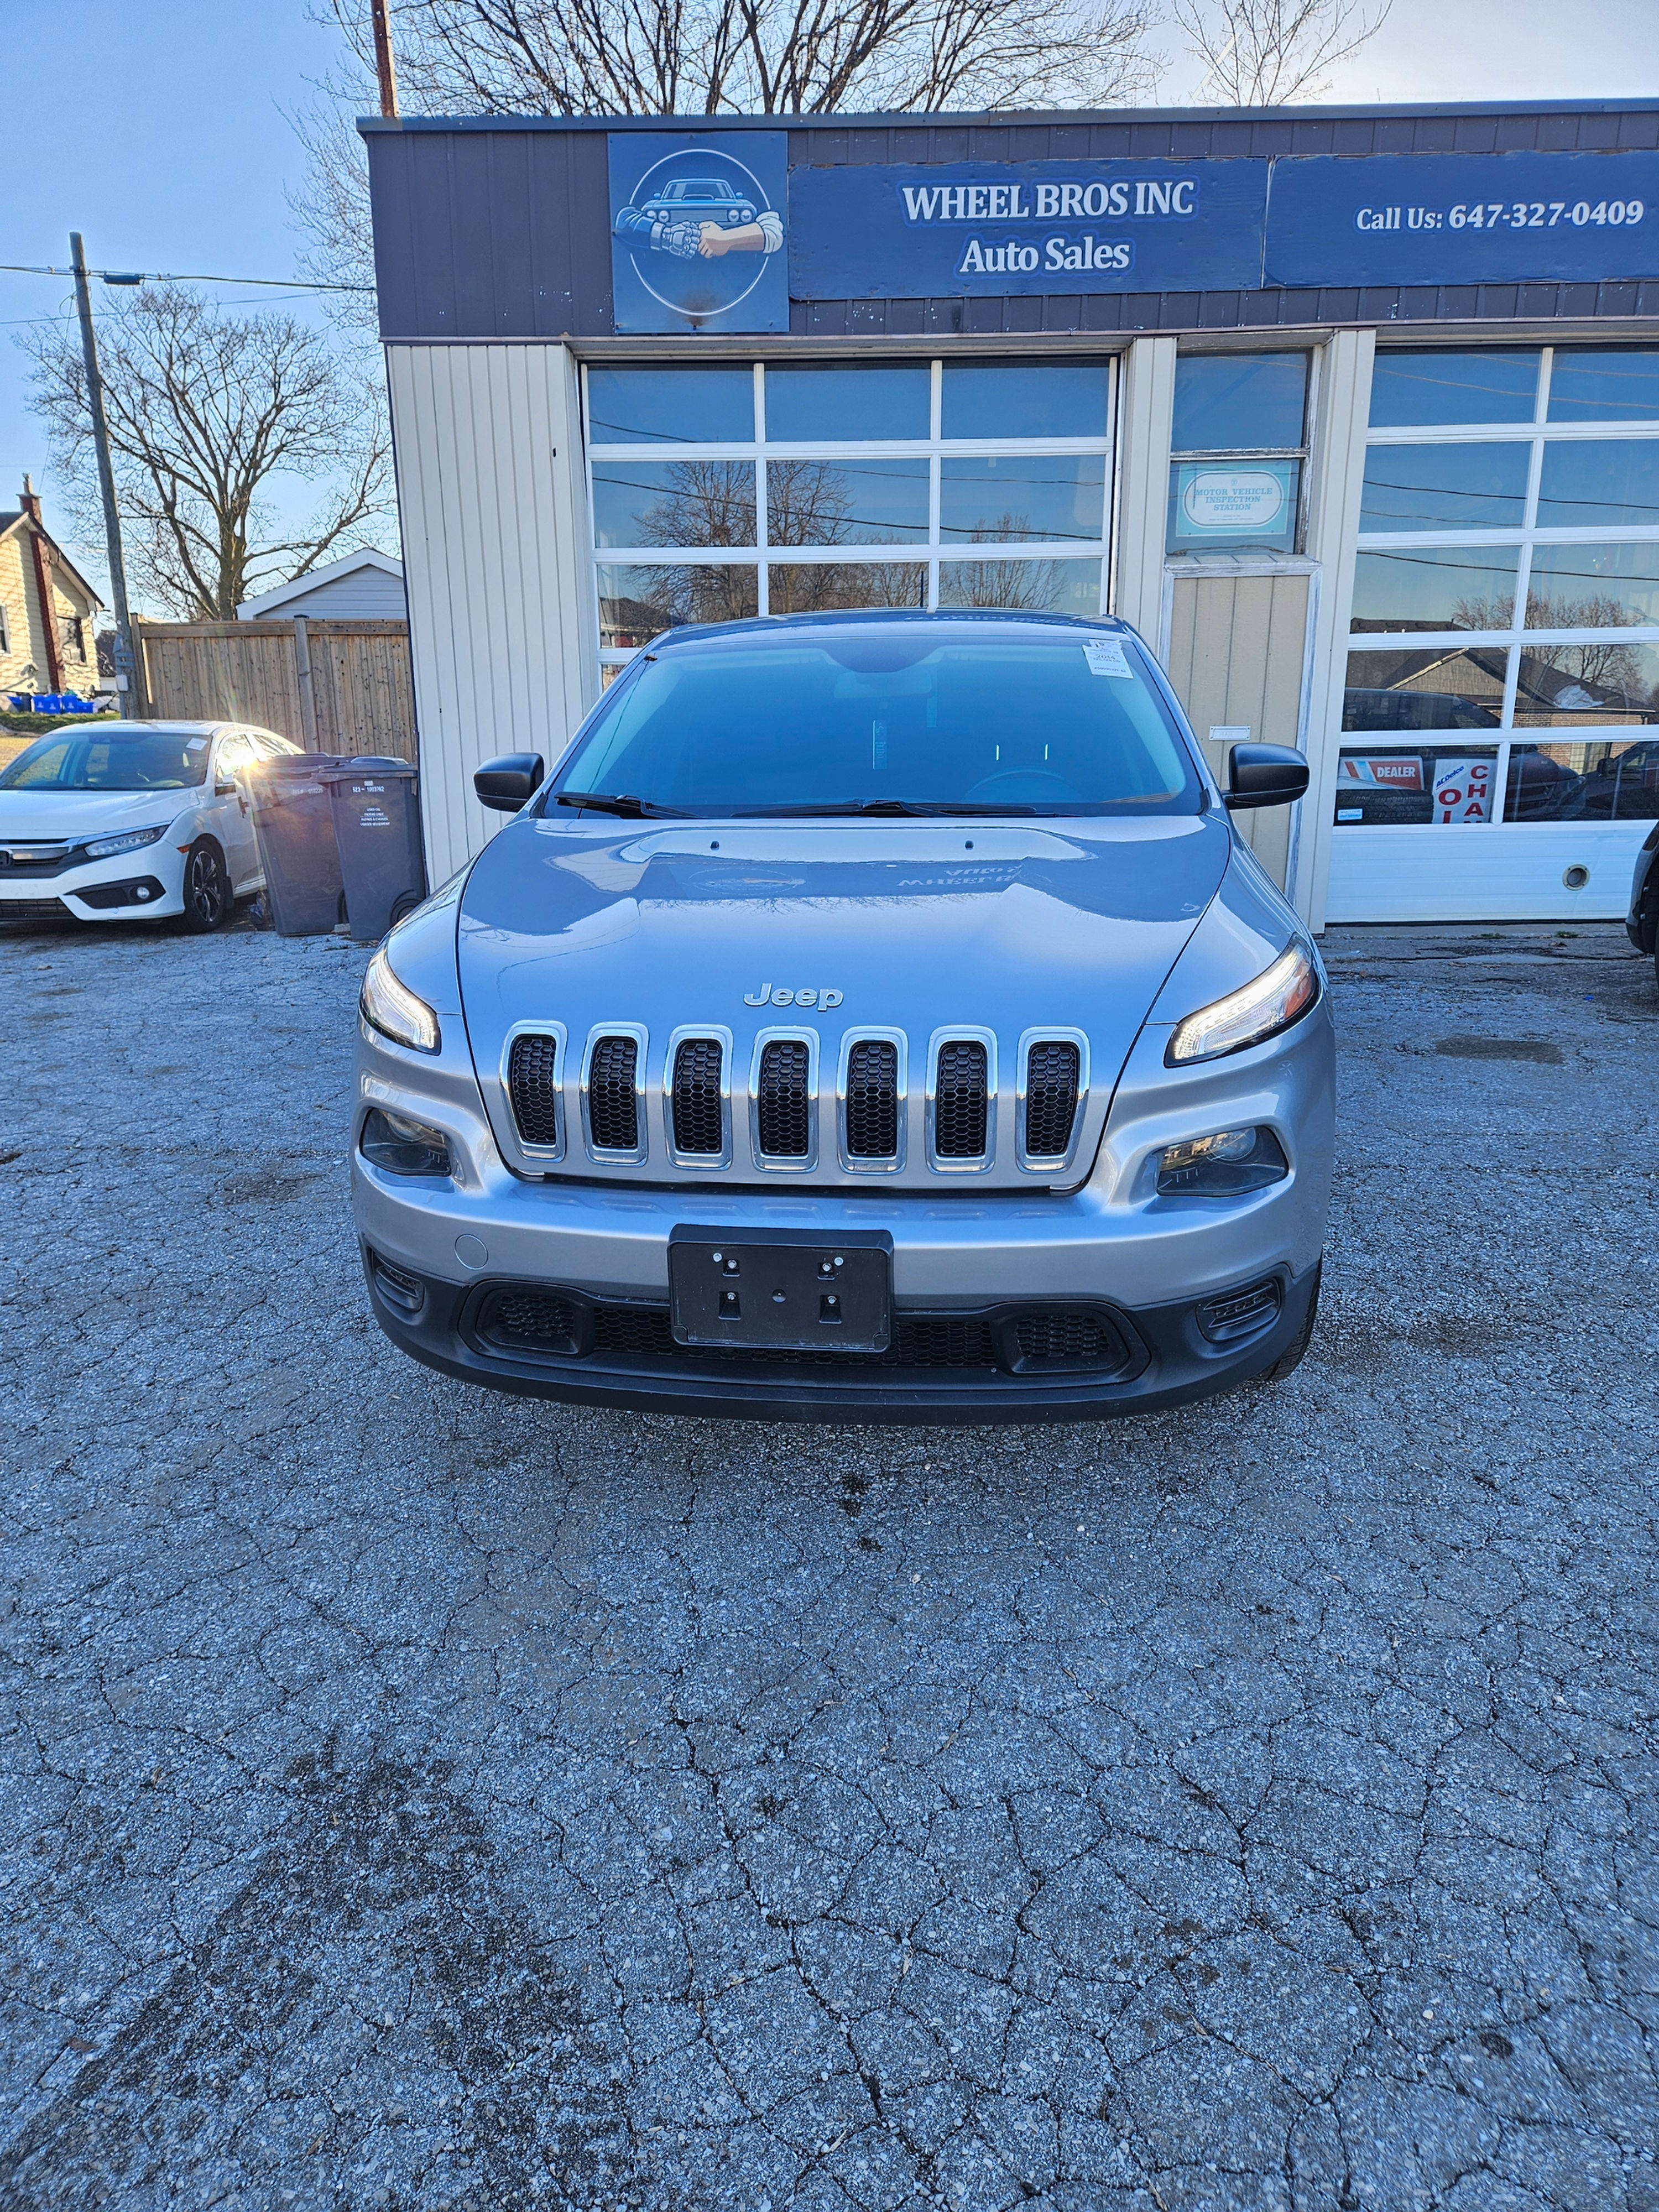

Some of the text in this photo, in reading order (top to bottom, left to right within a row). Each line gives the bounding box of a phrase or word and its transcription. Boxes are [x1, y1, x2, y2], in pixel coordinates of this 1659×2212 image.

[902, 181, 1194, 220] WHEEL BROS INC
[1357, 200, 1644, 230] Call Us: 647-327-0409
[959, 236, 1130, 273] Auto Sales
[1232, 487, 1273, 495] VEHICLE
[1376, 766, 1416, 778] DEALER
[1435, 765, 1465, 788] ACDelco
[743, 982, 844, 1012] Jeep
